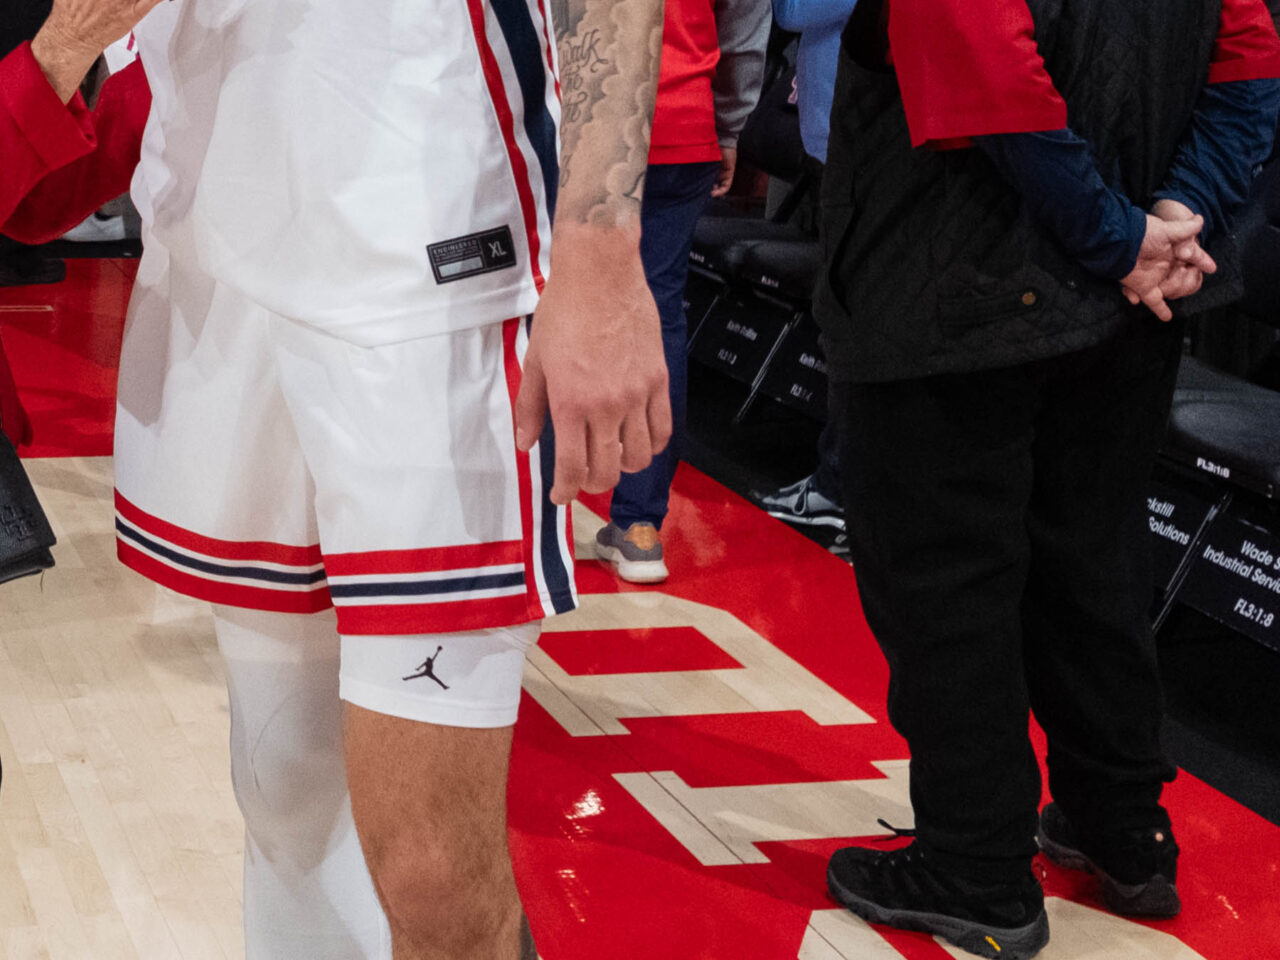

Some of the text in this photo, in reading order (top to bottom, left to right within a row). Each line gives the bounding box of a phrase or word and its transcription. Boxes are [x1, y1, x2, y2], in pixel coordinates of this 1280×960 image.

[488, 241, 507, 259] XL
[1202, 544, 1254, 579] Industrial
[1240, 540, 1273, 567] Wade
[1233, 597, 1275, 628] FL3:1:8
